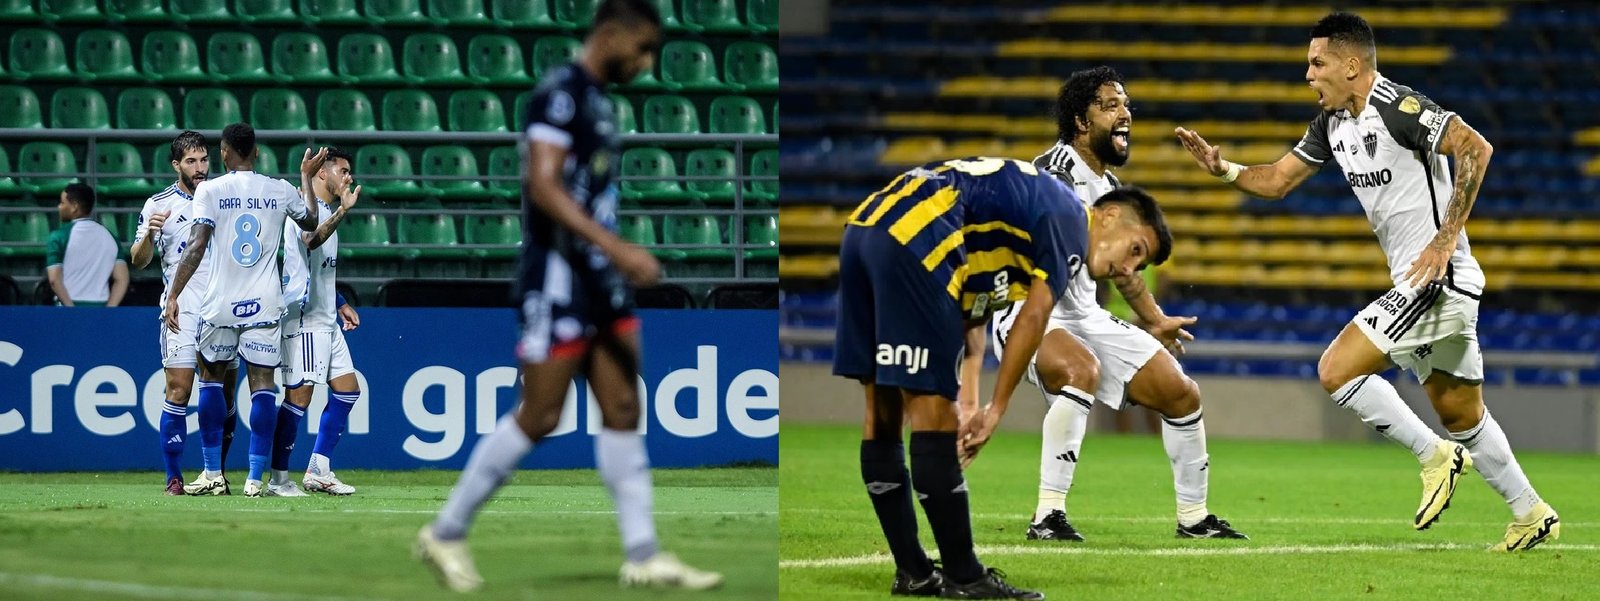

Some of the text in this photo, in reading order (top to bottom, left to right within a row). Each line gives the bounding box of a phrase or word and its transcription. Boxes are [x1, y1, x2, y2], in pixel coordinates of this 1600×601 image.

[1348, 168, 1392, 188] BETANO
[219, 198, 277, 210] RAFA SILVA
[231, 212, 264, 268] 8
[235, 302, 258, 316] BH
[245, 342, 278, 354] MULTIVIX
